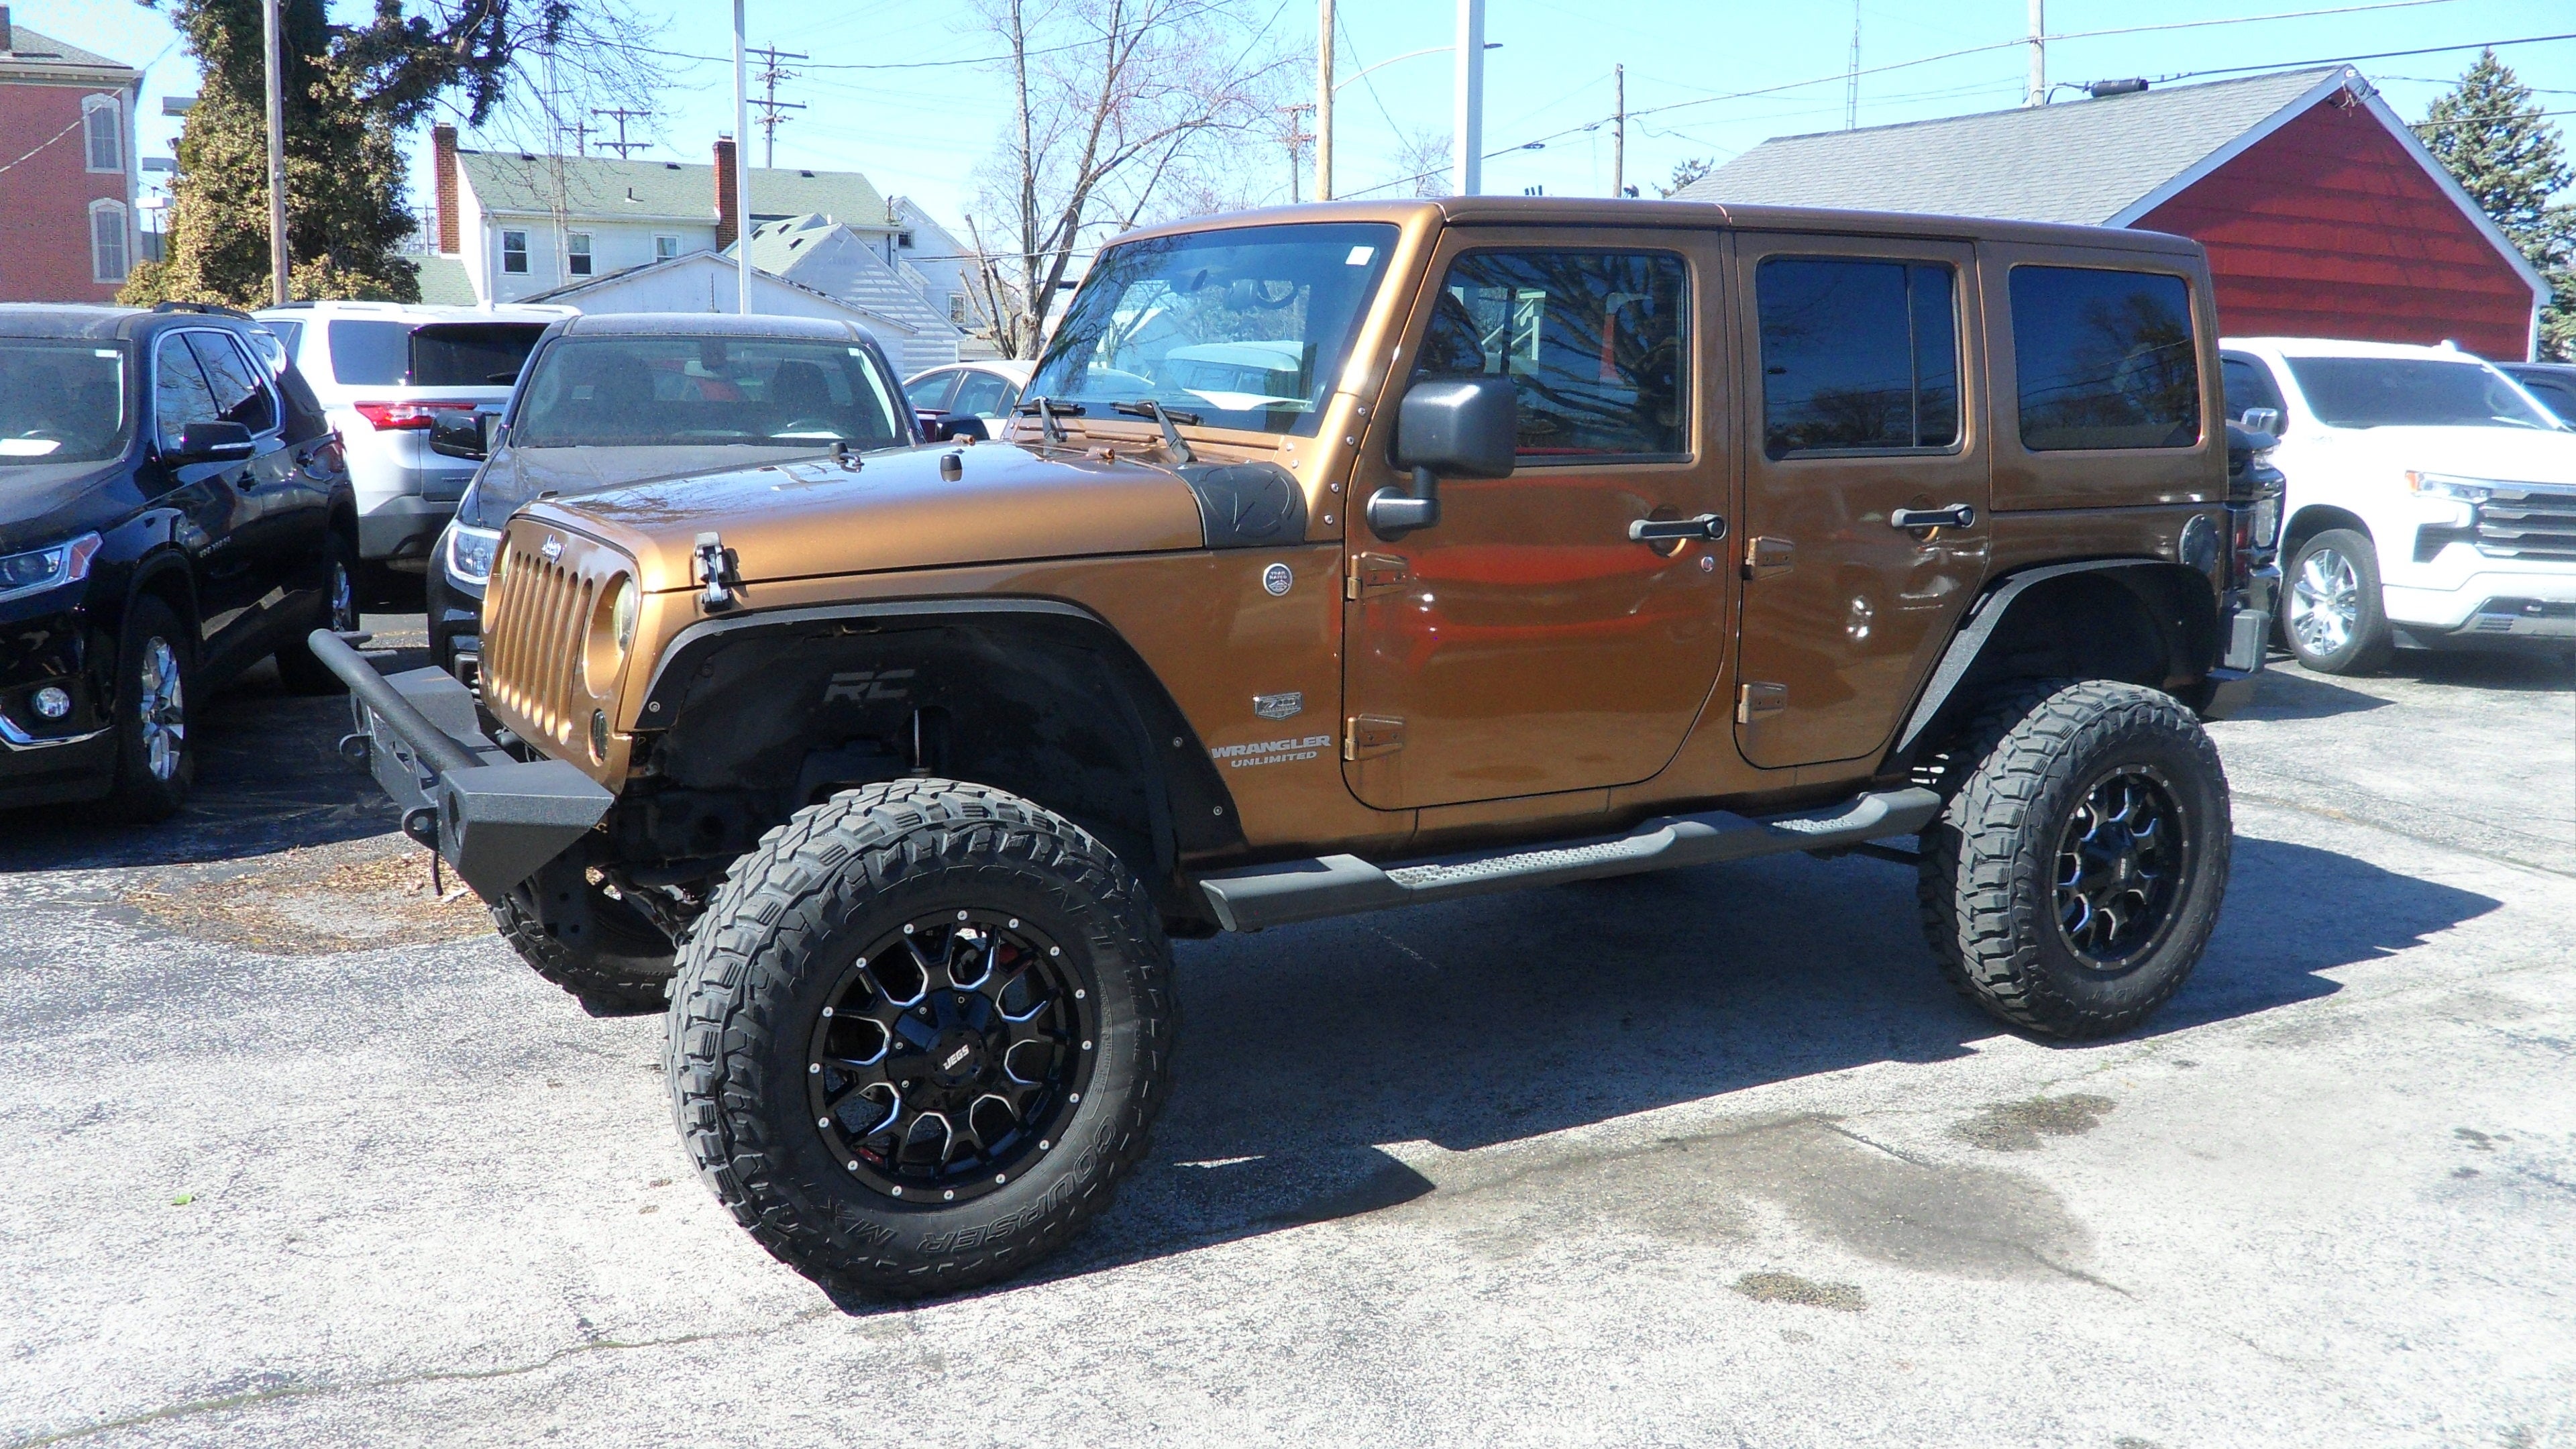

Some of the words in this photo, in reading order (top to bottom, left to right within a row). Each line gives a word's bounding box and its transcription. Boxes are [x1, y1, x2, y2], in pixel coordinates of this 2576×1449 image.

[824, 669, 915, 702] RC
[1212, 735, 1332, 759] WRANGLER
[1231, 751, 1318, 767] UNLIMITED
[943, 1044, 969, 1071] JEGS
[916, 1115, 1117, 1253] COURSER
